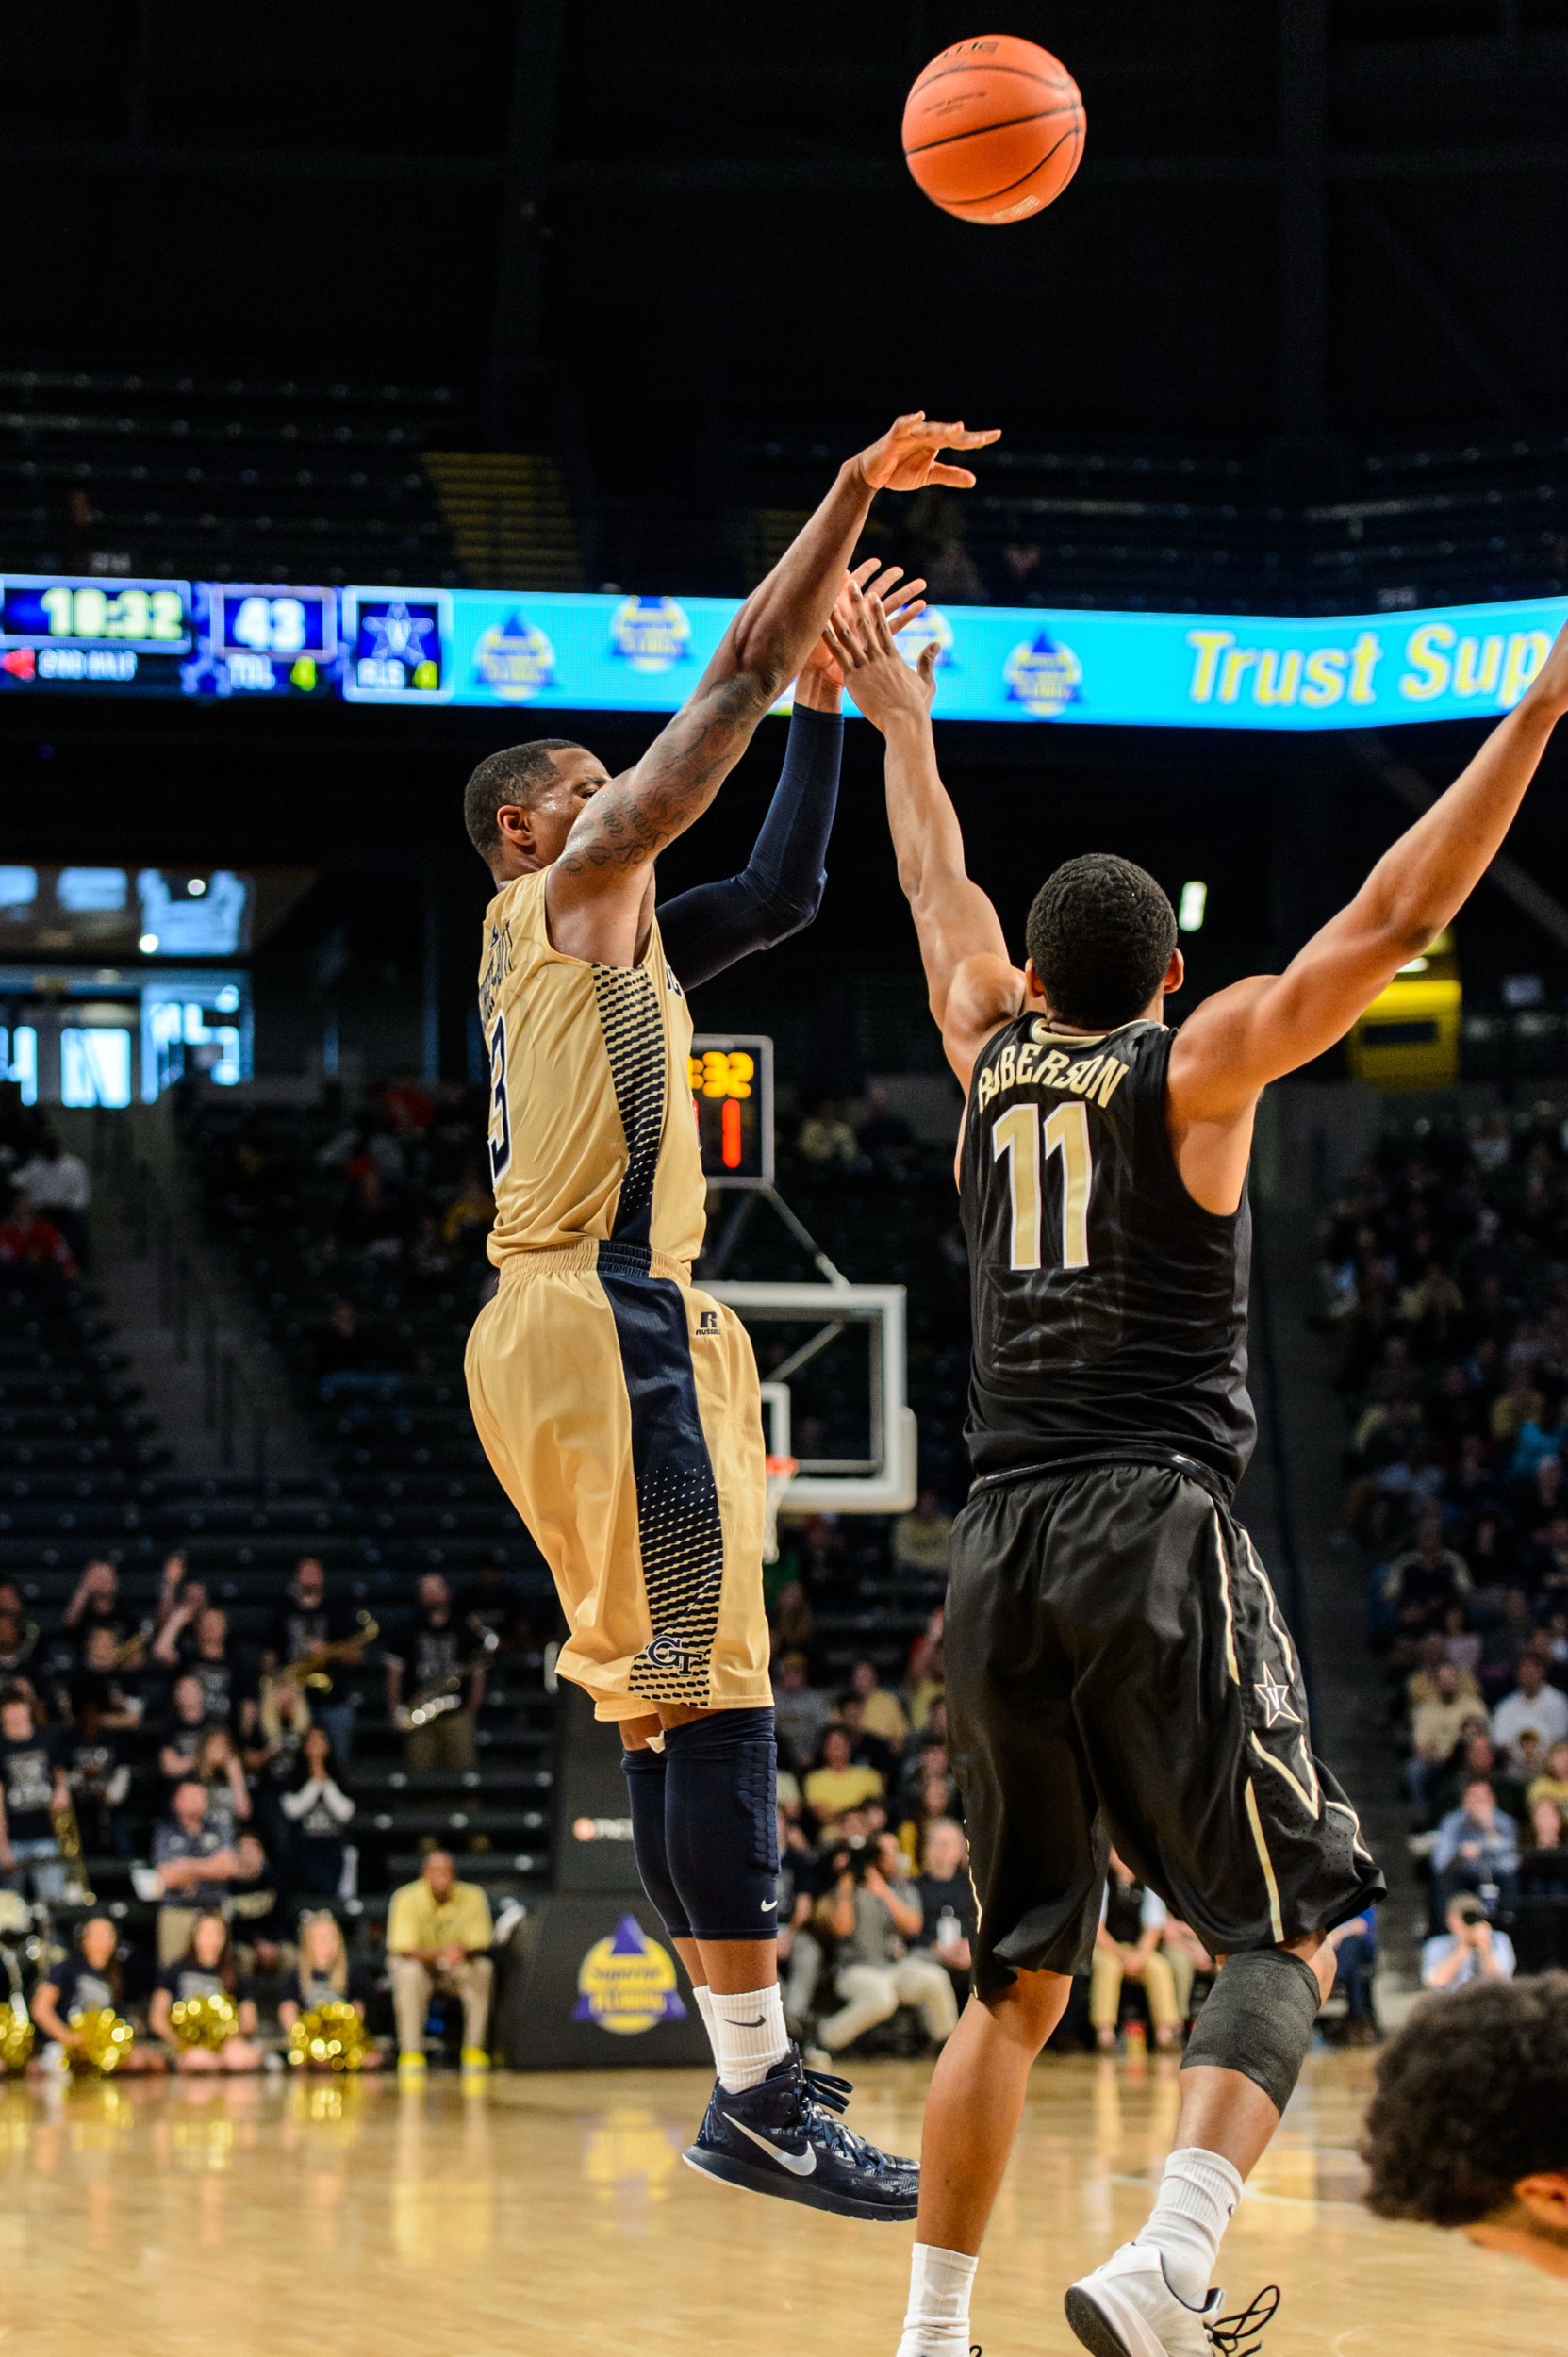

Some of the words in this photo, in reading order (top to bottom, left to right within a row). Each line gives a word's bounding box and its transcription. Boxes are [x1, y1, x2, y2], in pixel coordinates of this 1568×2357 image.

[41, 587, 183, 640] 10:32
[234, 597, 305, 652] 43
[1187, 629, 1383, 705] Trust
[992, 1101, 1092, 1270] 11
